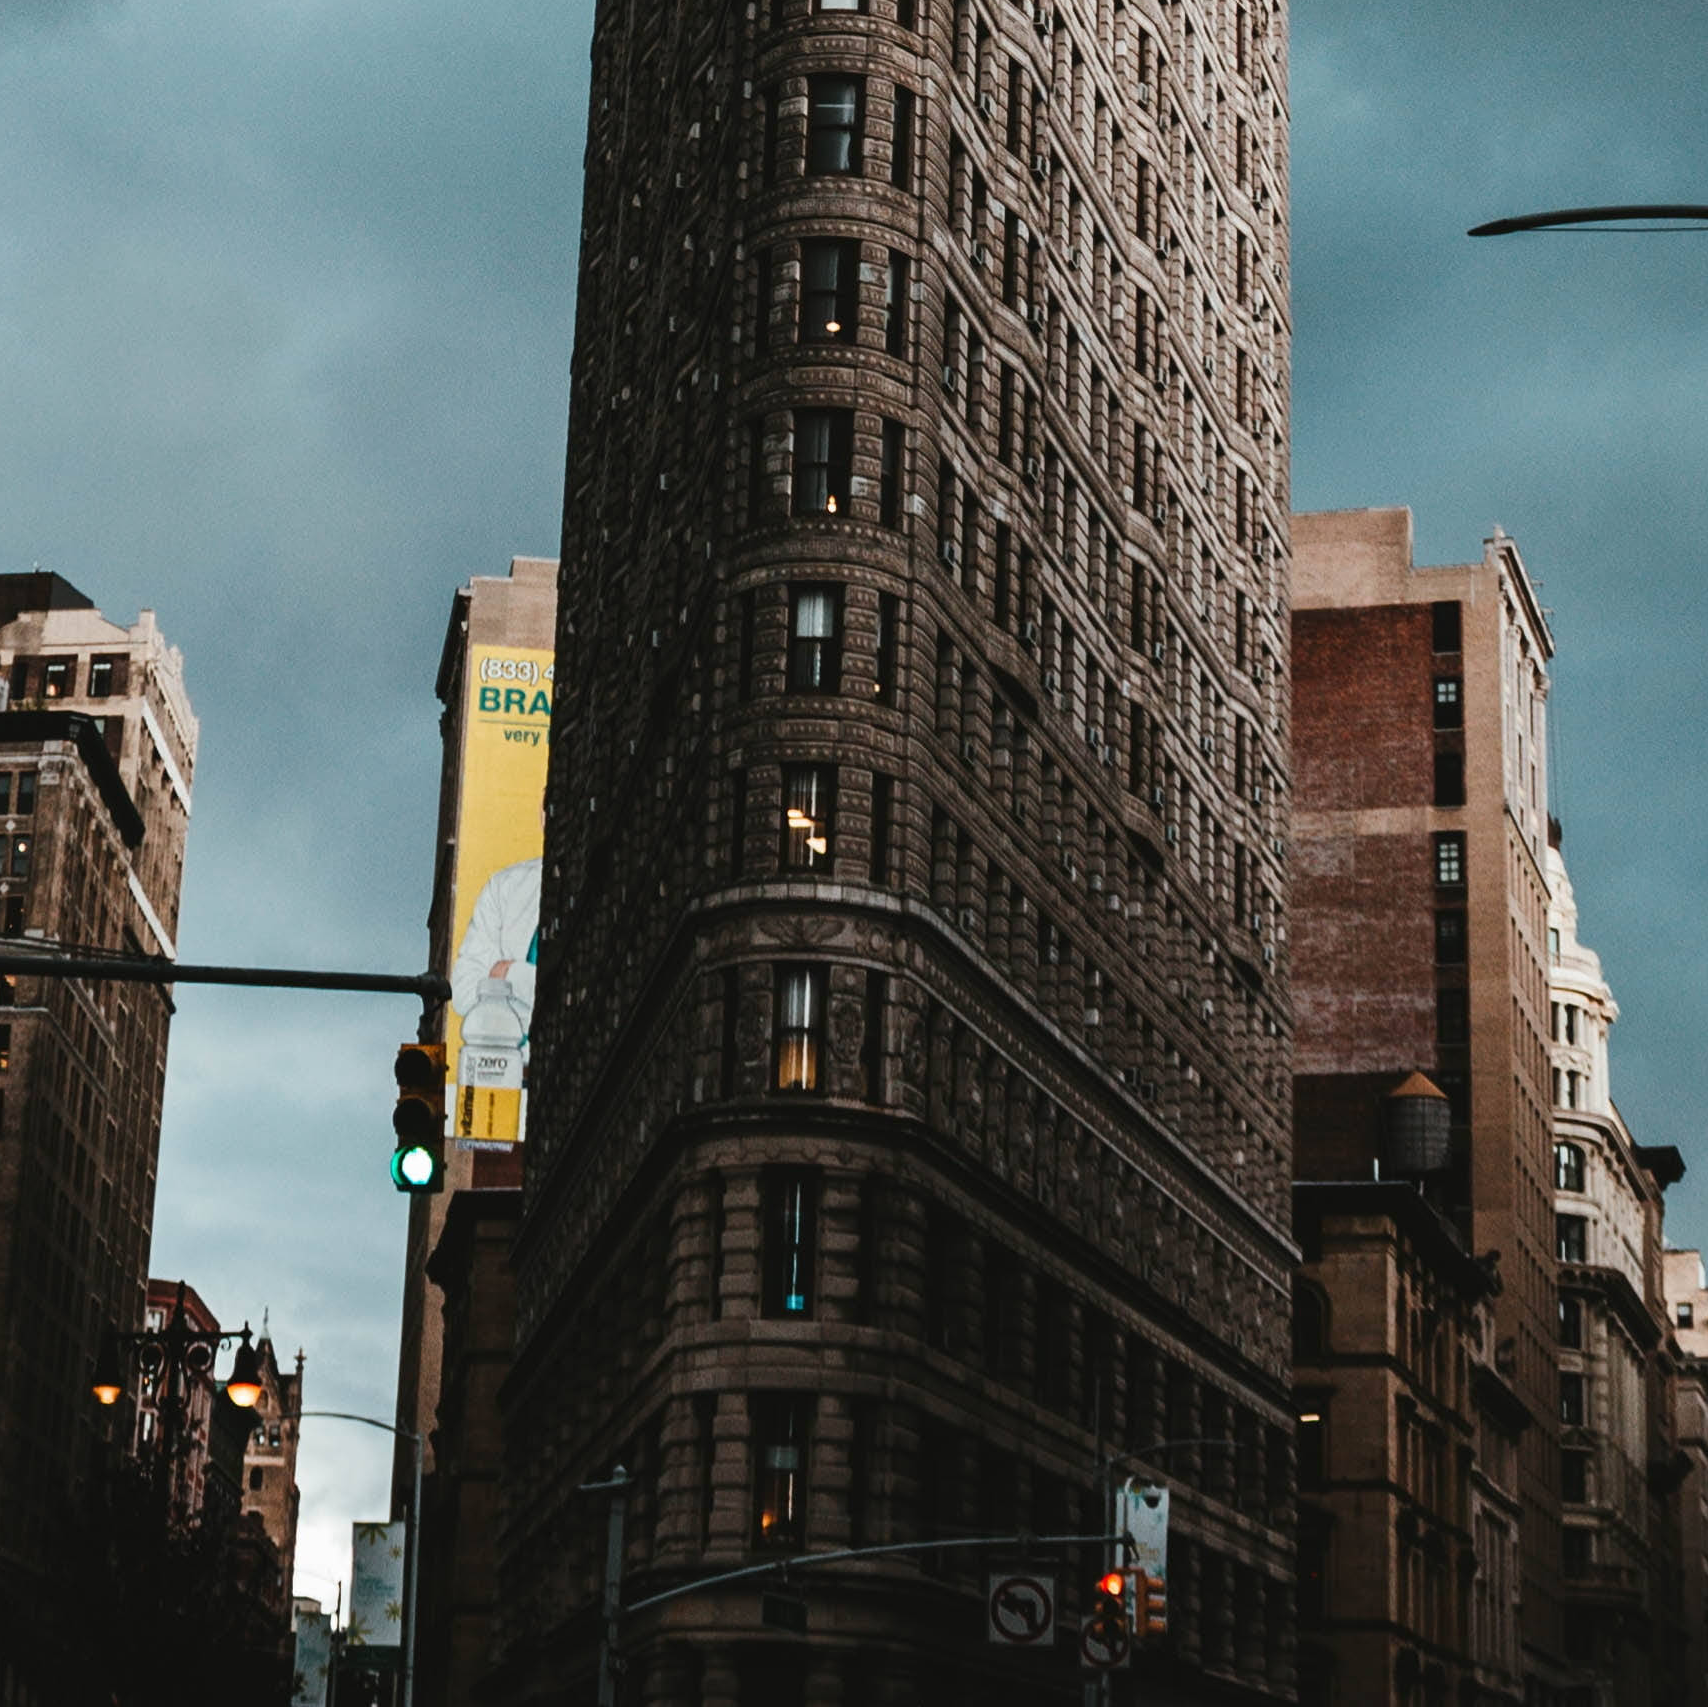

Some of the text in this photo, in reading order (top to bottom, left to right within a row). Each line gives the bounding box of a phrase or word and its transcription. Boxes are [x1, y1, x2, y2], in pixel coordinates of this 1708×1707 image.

[480, 657, 540, 687] (833)
[504, 729, 541, 747] very
[478, 1056, 508, 1070] zero
